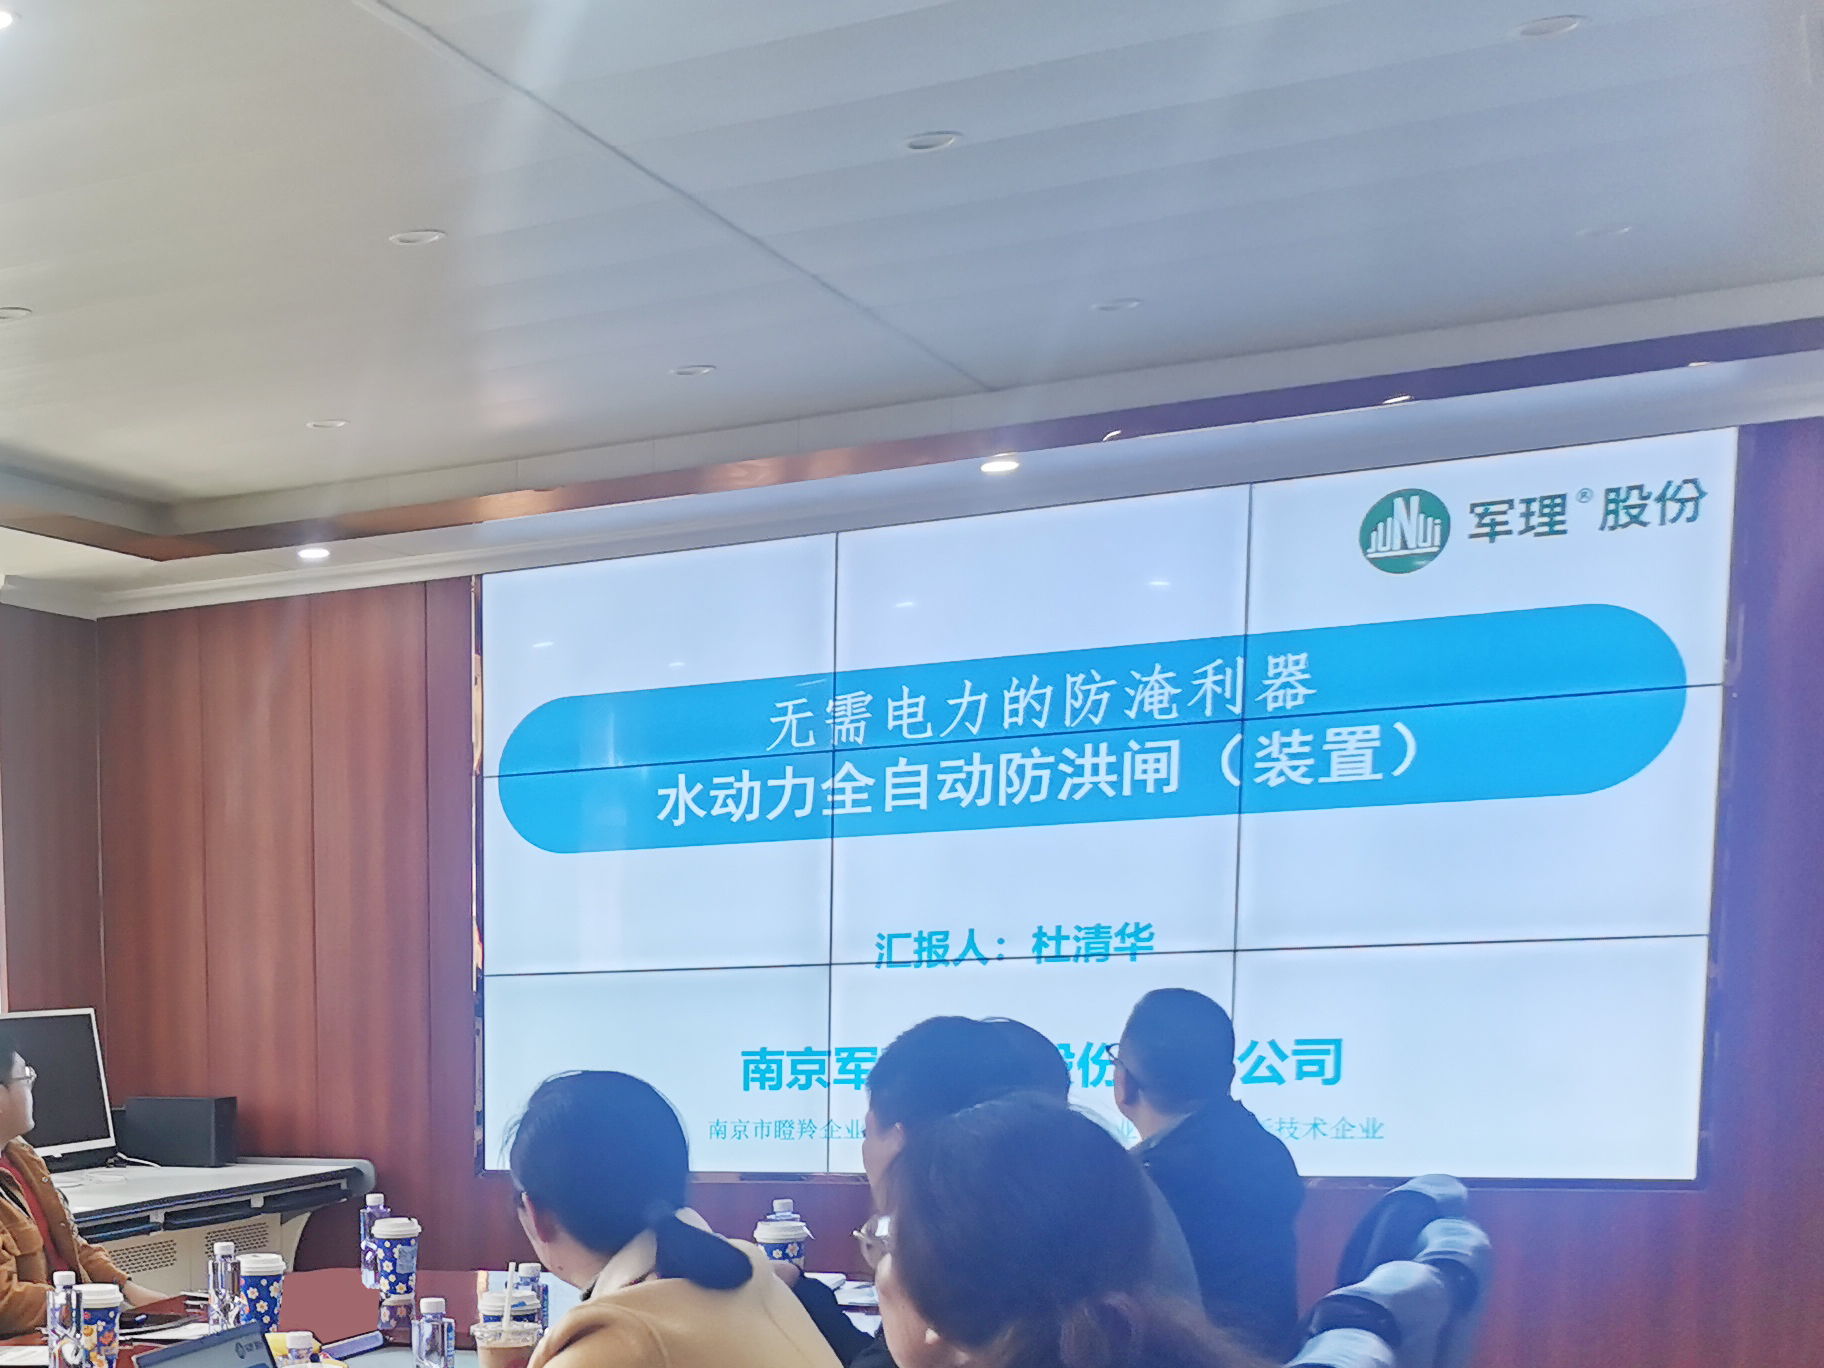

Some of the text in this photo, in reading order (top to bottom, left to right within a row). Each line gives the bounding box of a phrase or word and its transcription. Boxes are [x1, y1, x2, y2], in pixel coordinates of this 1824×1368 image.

[766, 652, 1318, 751] 无需电力的防淹利器
